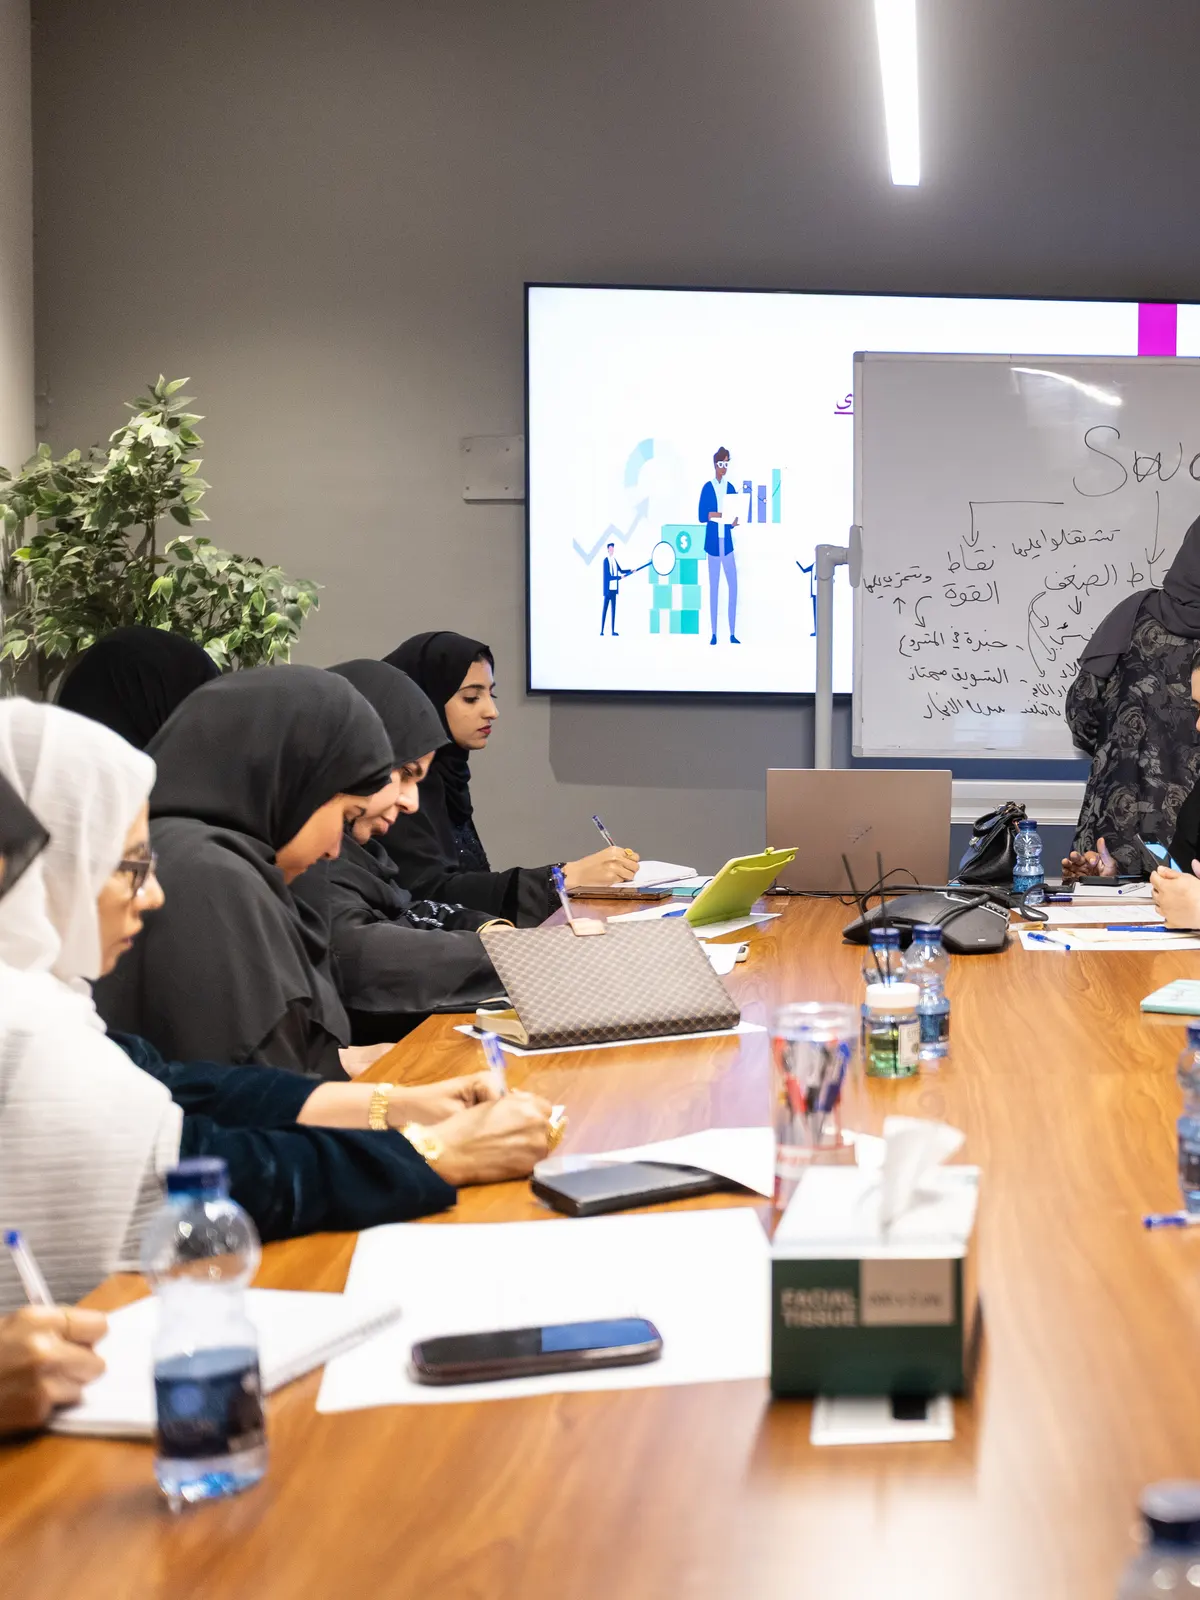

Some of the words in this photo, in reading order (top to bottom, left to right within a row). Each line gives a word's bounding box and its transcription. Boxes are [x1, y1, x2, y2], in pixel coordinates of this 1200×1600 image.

[948, 544, 996, 574] نقاط
[942, 580, 1000, 608] القوة
[1044, 564, 1118, 597] الضعف
[951, 667, 1009, 690] التسويق
